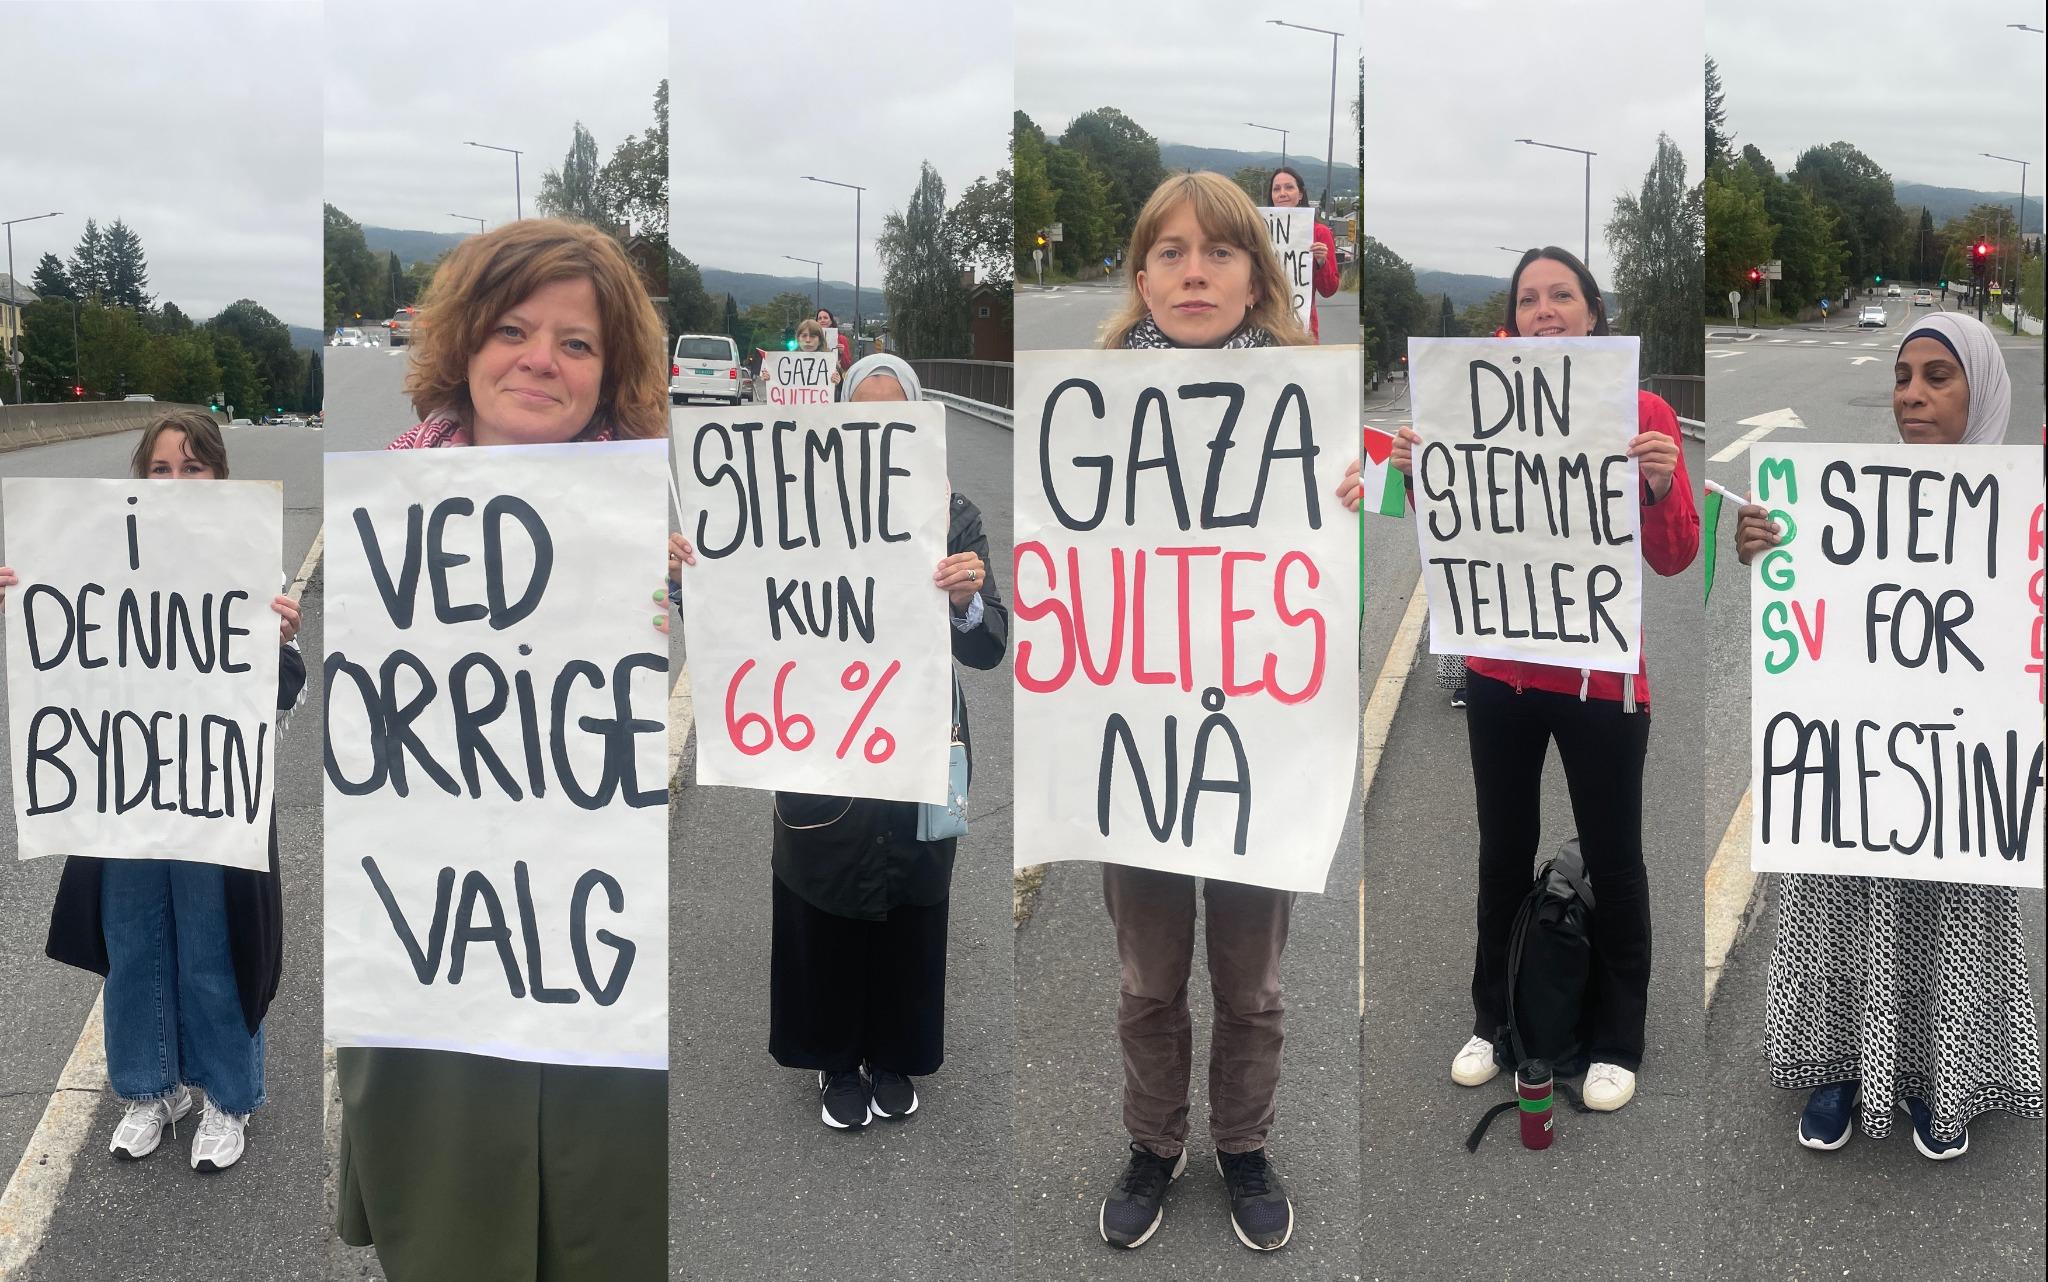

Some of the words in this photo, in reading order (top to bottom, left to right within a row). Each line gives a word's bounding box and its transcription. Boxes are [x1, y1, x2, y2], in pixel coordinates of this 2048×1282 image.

[778, 356, 829, 386] GAZA
[693, 421, 917, 559] STEMTE
[1039, 377, 1321, 531] GAZA
[1420, 441, 1634, 546] STEMME
[352, 494, 554, 631] VED
[1820, 460, 2000, 579] STEM
[22, 582, 252, 674] DENNE
[766, 575, 875, 644] KUN
[1014, 540, 1326, 705] SULTES
[1429, 557, 1630, 653] TELLER
[1762, 599, 1826, 675] SV
[1865, 583, 1985, 674] FOR
[25, 705, 267, 824] BYDELEN
[1097, 686, 1253, 856] NÅ
[361, 855, 637, 1007] VALG
